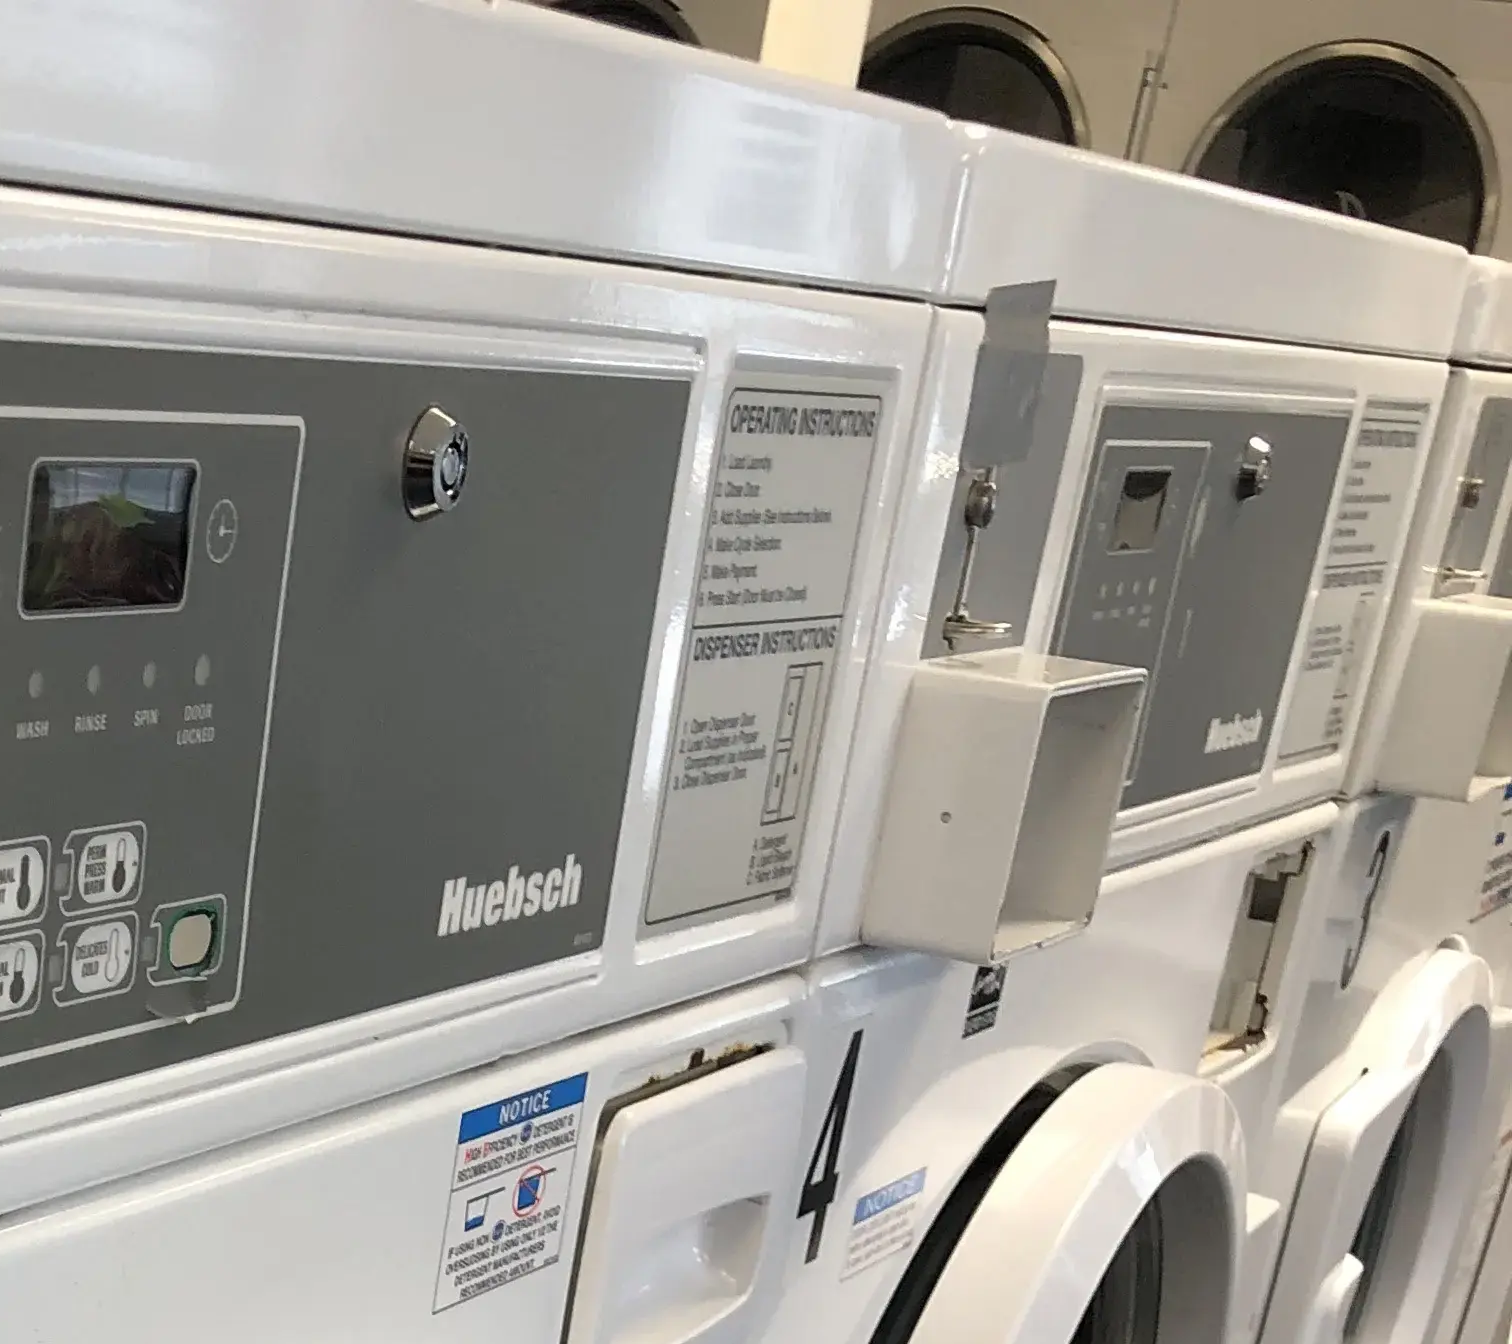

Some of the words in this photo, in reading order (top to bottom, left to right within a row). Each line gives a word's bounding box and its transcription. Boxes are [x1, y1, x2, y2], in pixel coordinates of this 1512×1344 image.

[16, 720, 49, 739] WASH
[74, 713, 107, 733] RINSE
[133, 708, 160, 727] SPIN
[437, 853, 582, 937] Huebsch
[498, 1089, 553, 1126] NOTICE
[796, 1028, 864, 1265] 4
